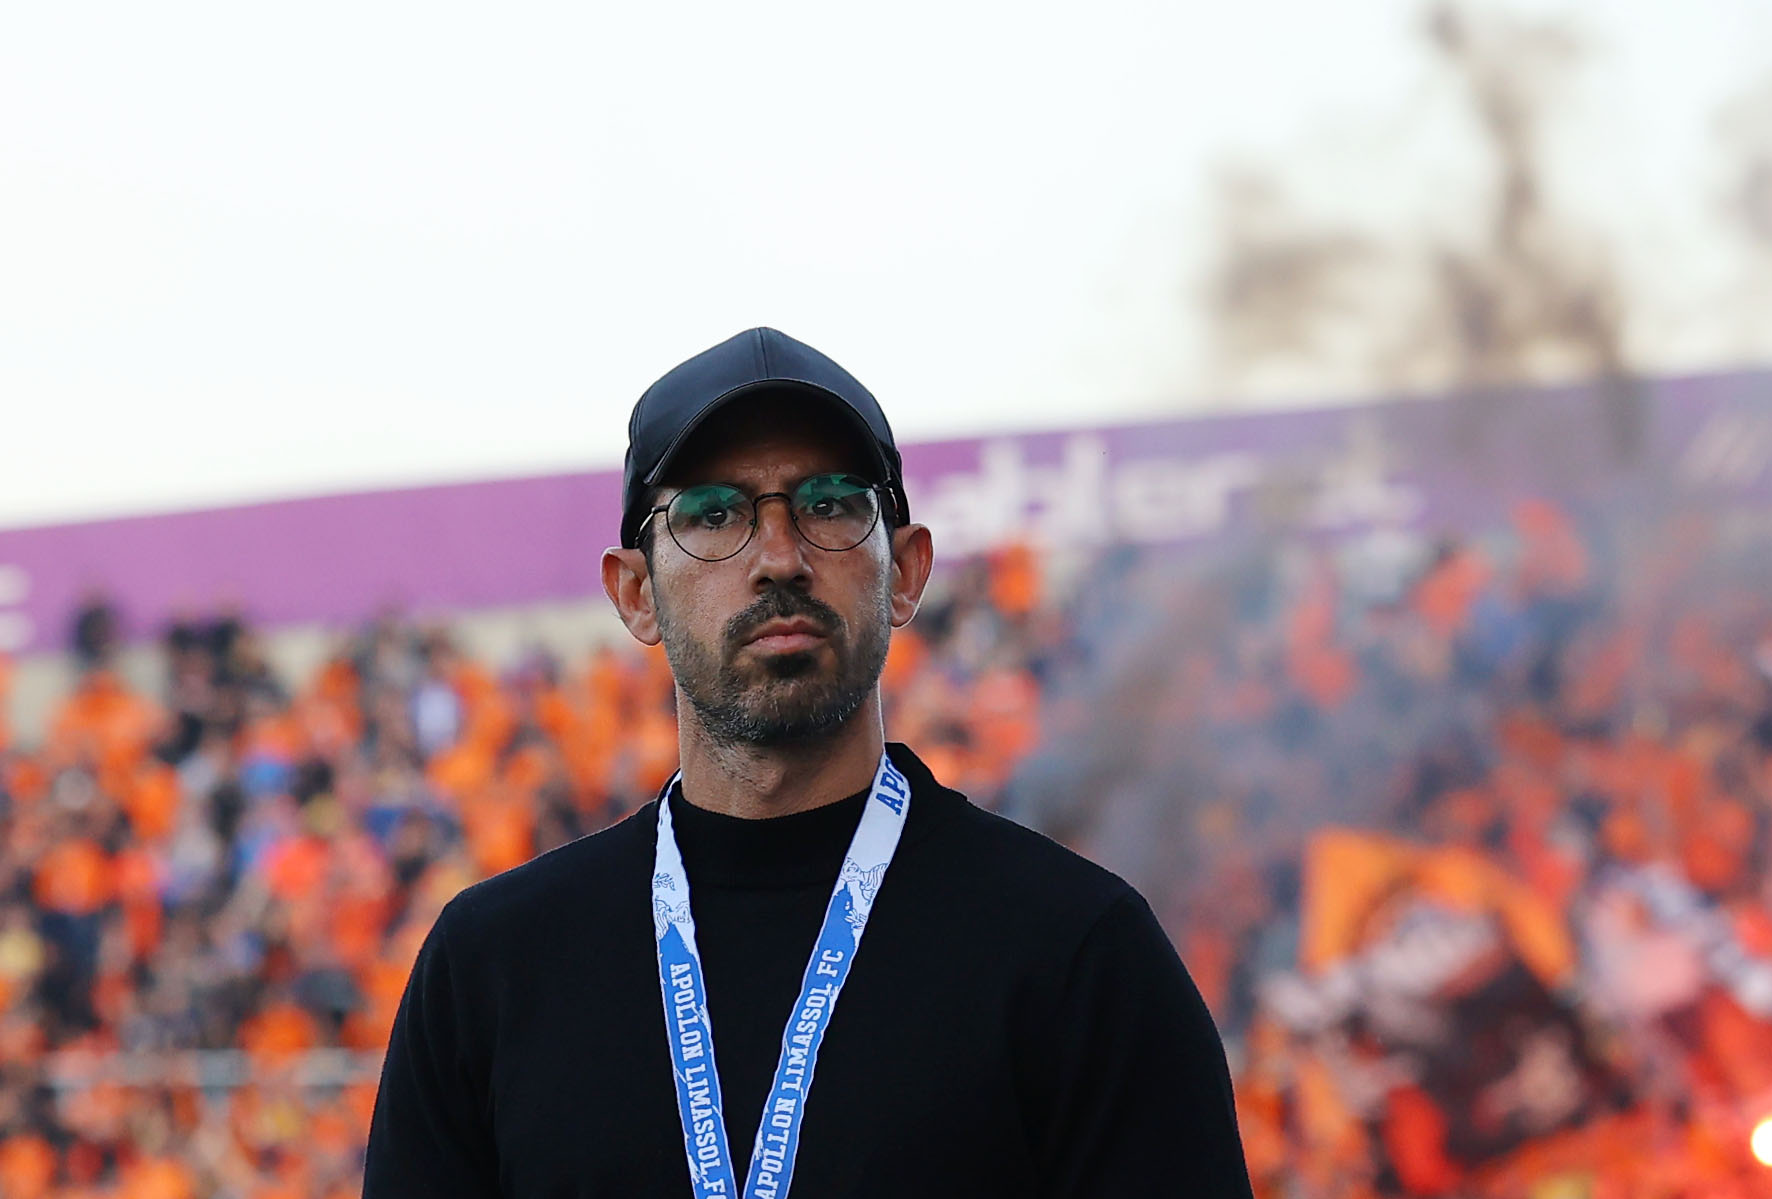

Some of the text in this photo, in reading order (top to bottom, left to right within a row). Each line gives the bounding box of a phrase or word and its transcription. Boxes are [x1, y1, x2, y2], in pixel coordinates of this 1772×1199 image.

[670, 962, 705, 1061] APOLLON
[781, 983, 832, 1092] LIMASSOL
[817, 949, 844, 978] FC
[686, 1063, 721, 1176] LIMASSOL
